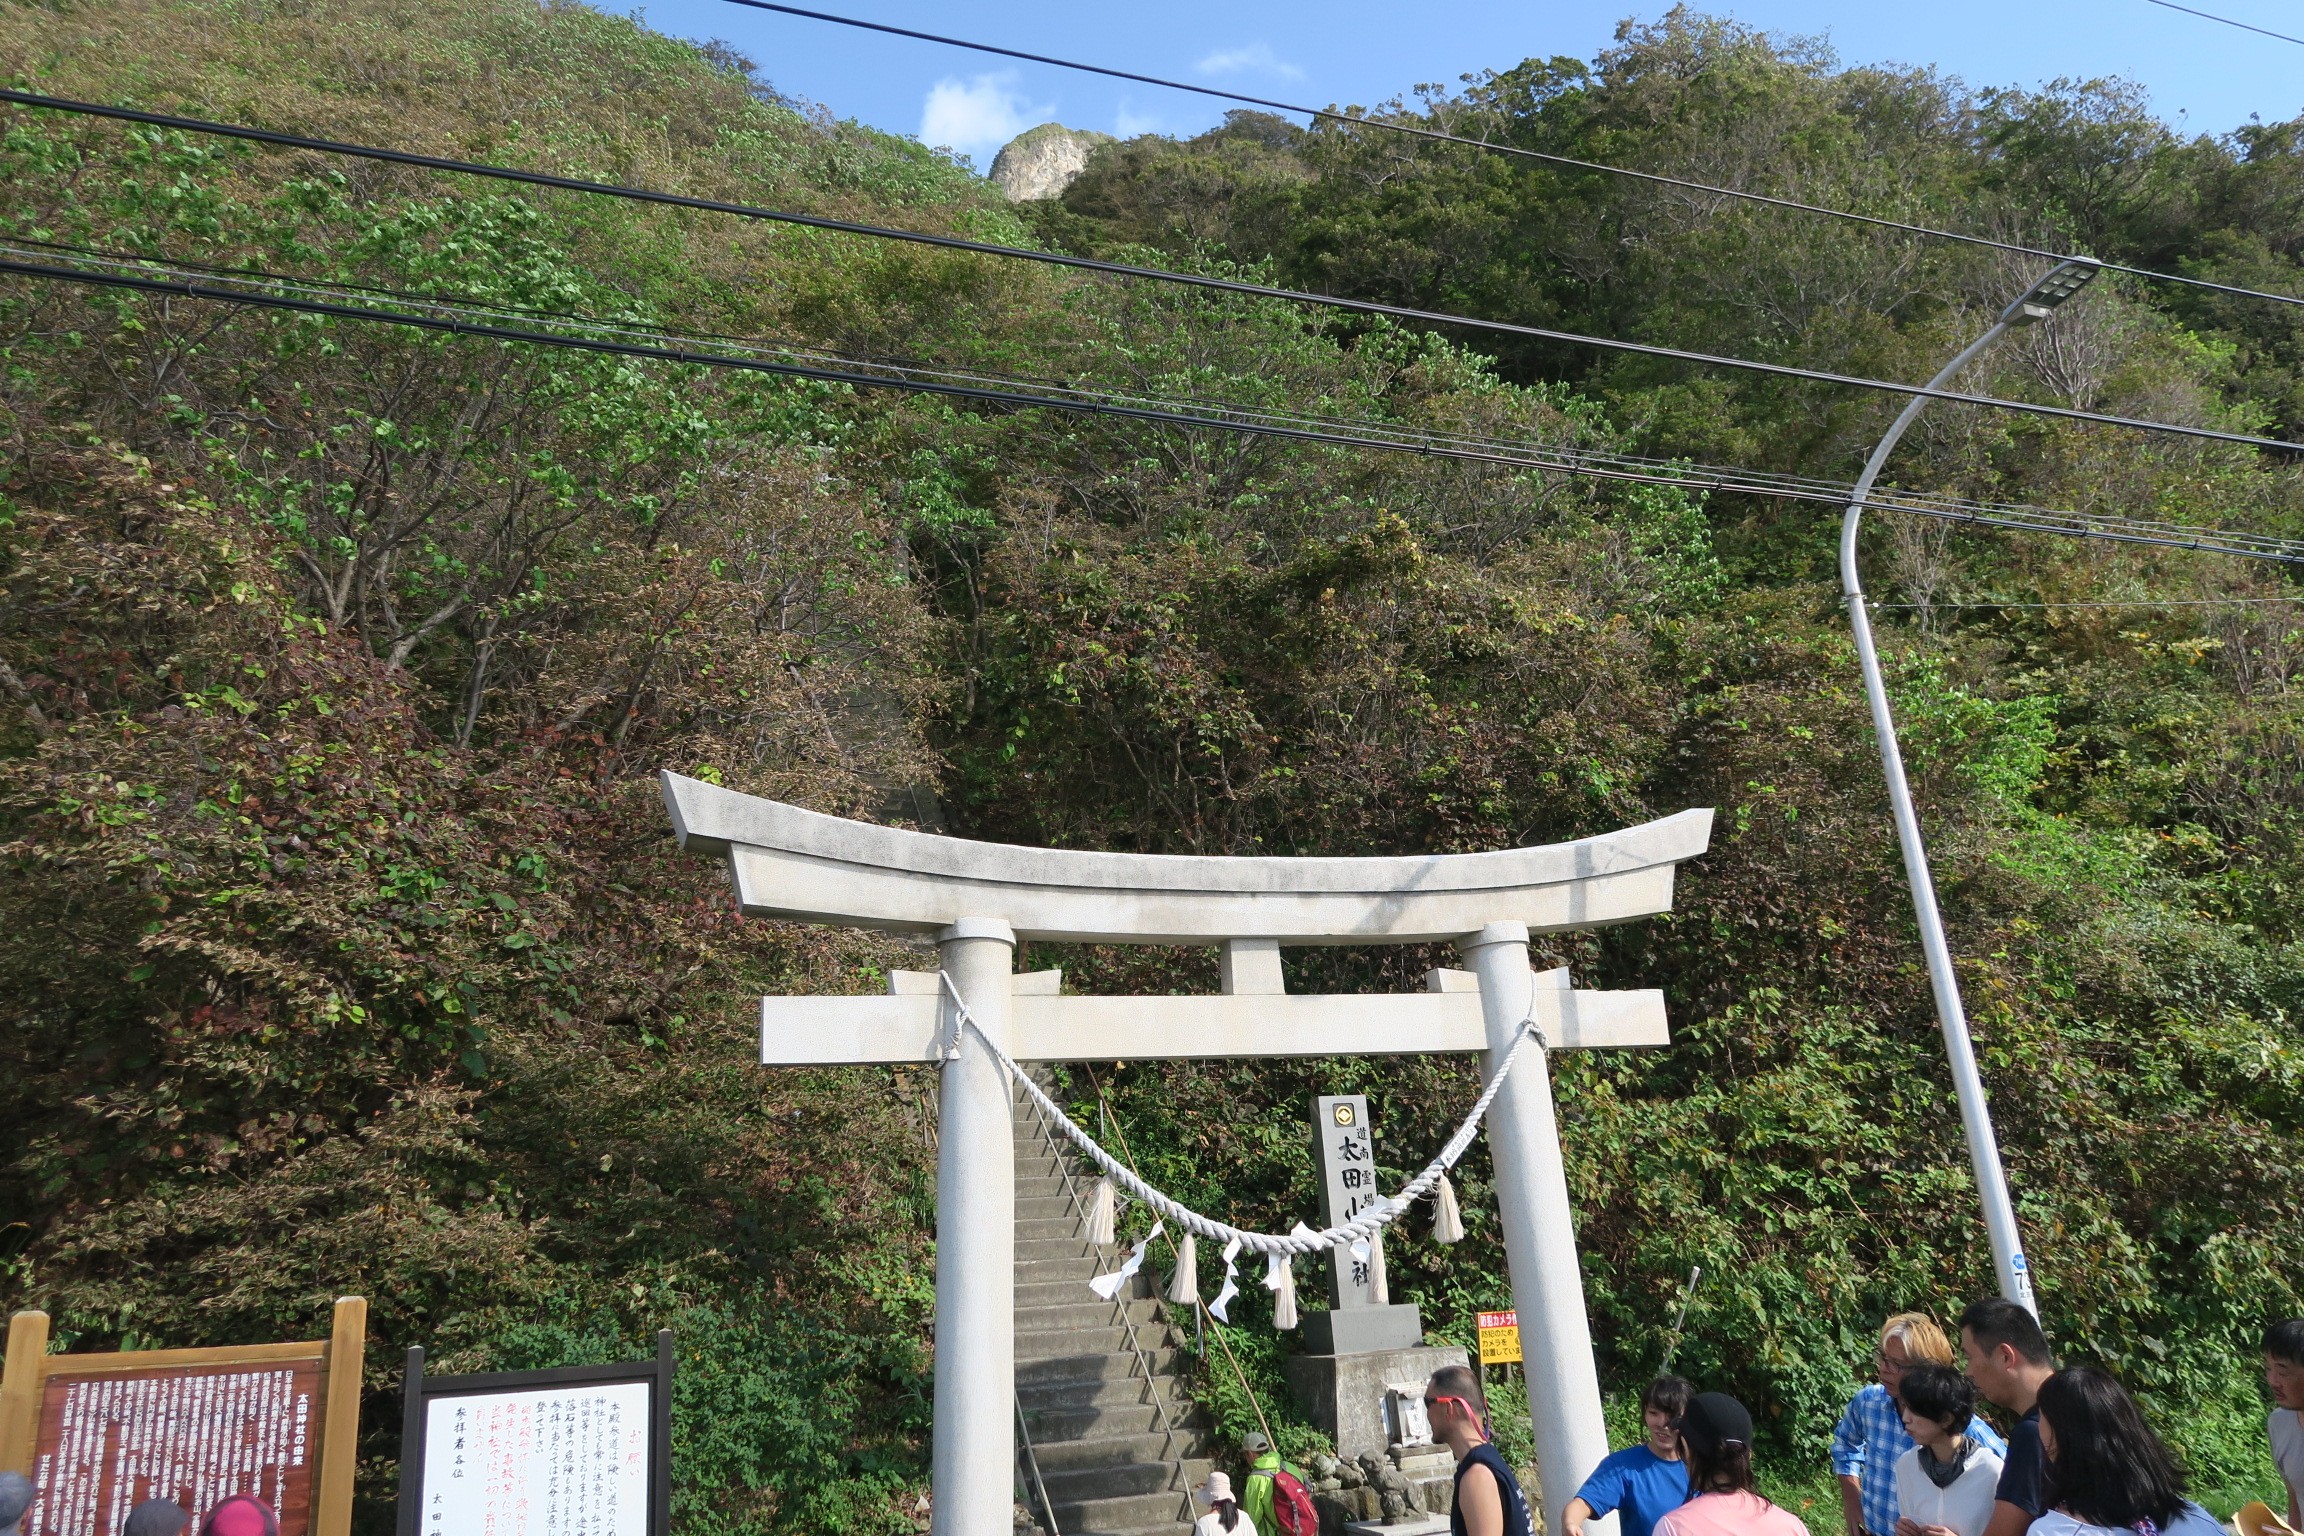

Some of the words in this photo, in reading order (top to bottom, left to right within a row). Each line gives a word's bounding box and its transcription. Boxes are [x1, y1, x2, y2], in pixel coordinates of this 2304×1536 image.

[1337, 1136, 1370, 1287] 太田山社
[1481, 1329, 1514, 1338] 防犯のため
[1482, 1338, 1507, 1347] カメラを
[293, 1393, 309, 1466] 太田神社の由来
[451, 1406, 467, 1478] 参拝者各位
[534, 1400, 548, 1453] 登って下さい
[625, 1429, 642, 1476] お願い
